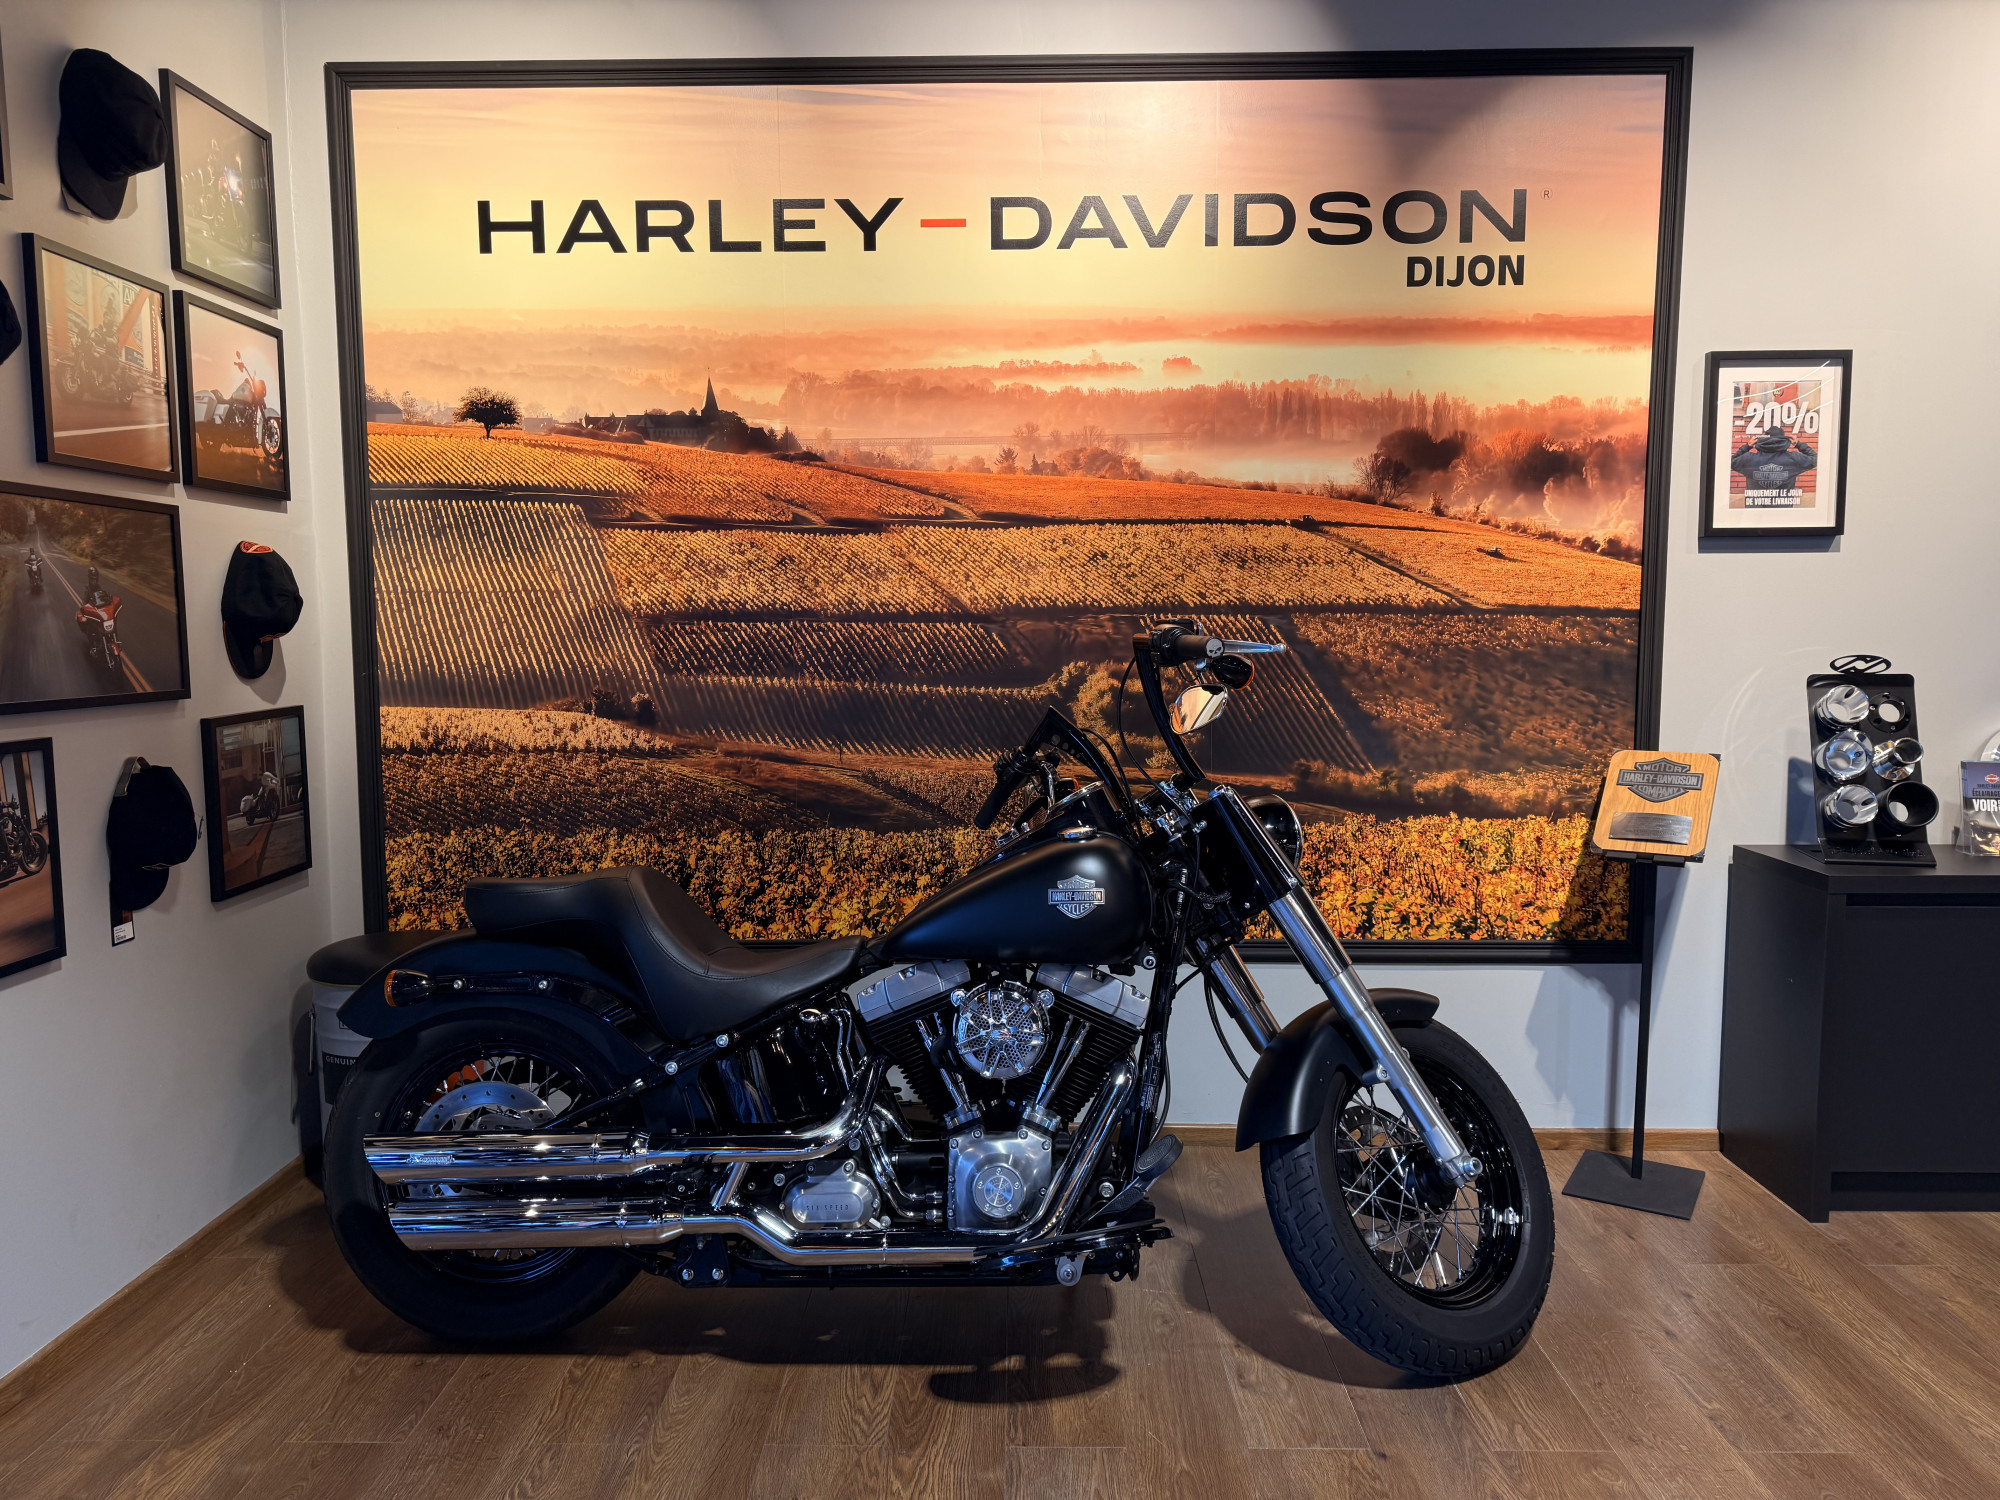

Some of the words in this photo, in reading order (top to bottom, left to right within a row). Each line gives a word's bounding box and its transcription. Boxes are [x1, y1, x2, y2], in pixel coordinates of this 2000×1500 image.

[477, 188, 1528, 255] HARLEY-DAVIDSON
[1405, 254, 1526, 288] DIJON
[1734, 401, 1820, 435] -20%
[1744, 489, 1779, 497] UNIQUEMENT
[1780, 489, 1787, 497] LE
[1788, 489, 1803, 497] JOUR
[1754, 497, 1772, 505] VOTRE
[1772, 497, 1801, 505] LIVRAISON
[1643, 764, 1682, 773] MOTOR
[1623, 773, 1698, 786] HARLEY-DAVIDSON
[1638, 785, 1680, 798] COMPANY
[1973, 799, 1997, 812] VOIR
[1052, 892, 1101, 901] HARLEY-DAVIDSON
[1063, 903, 1090, 915] CYCLES
